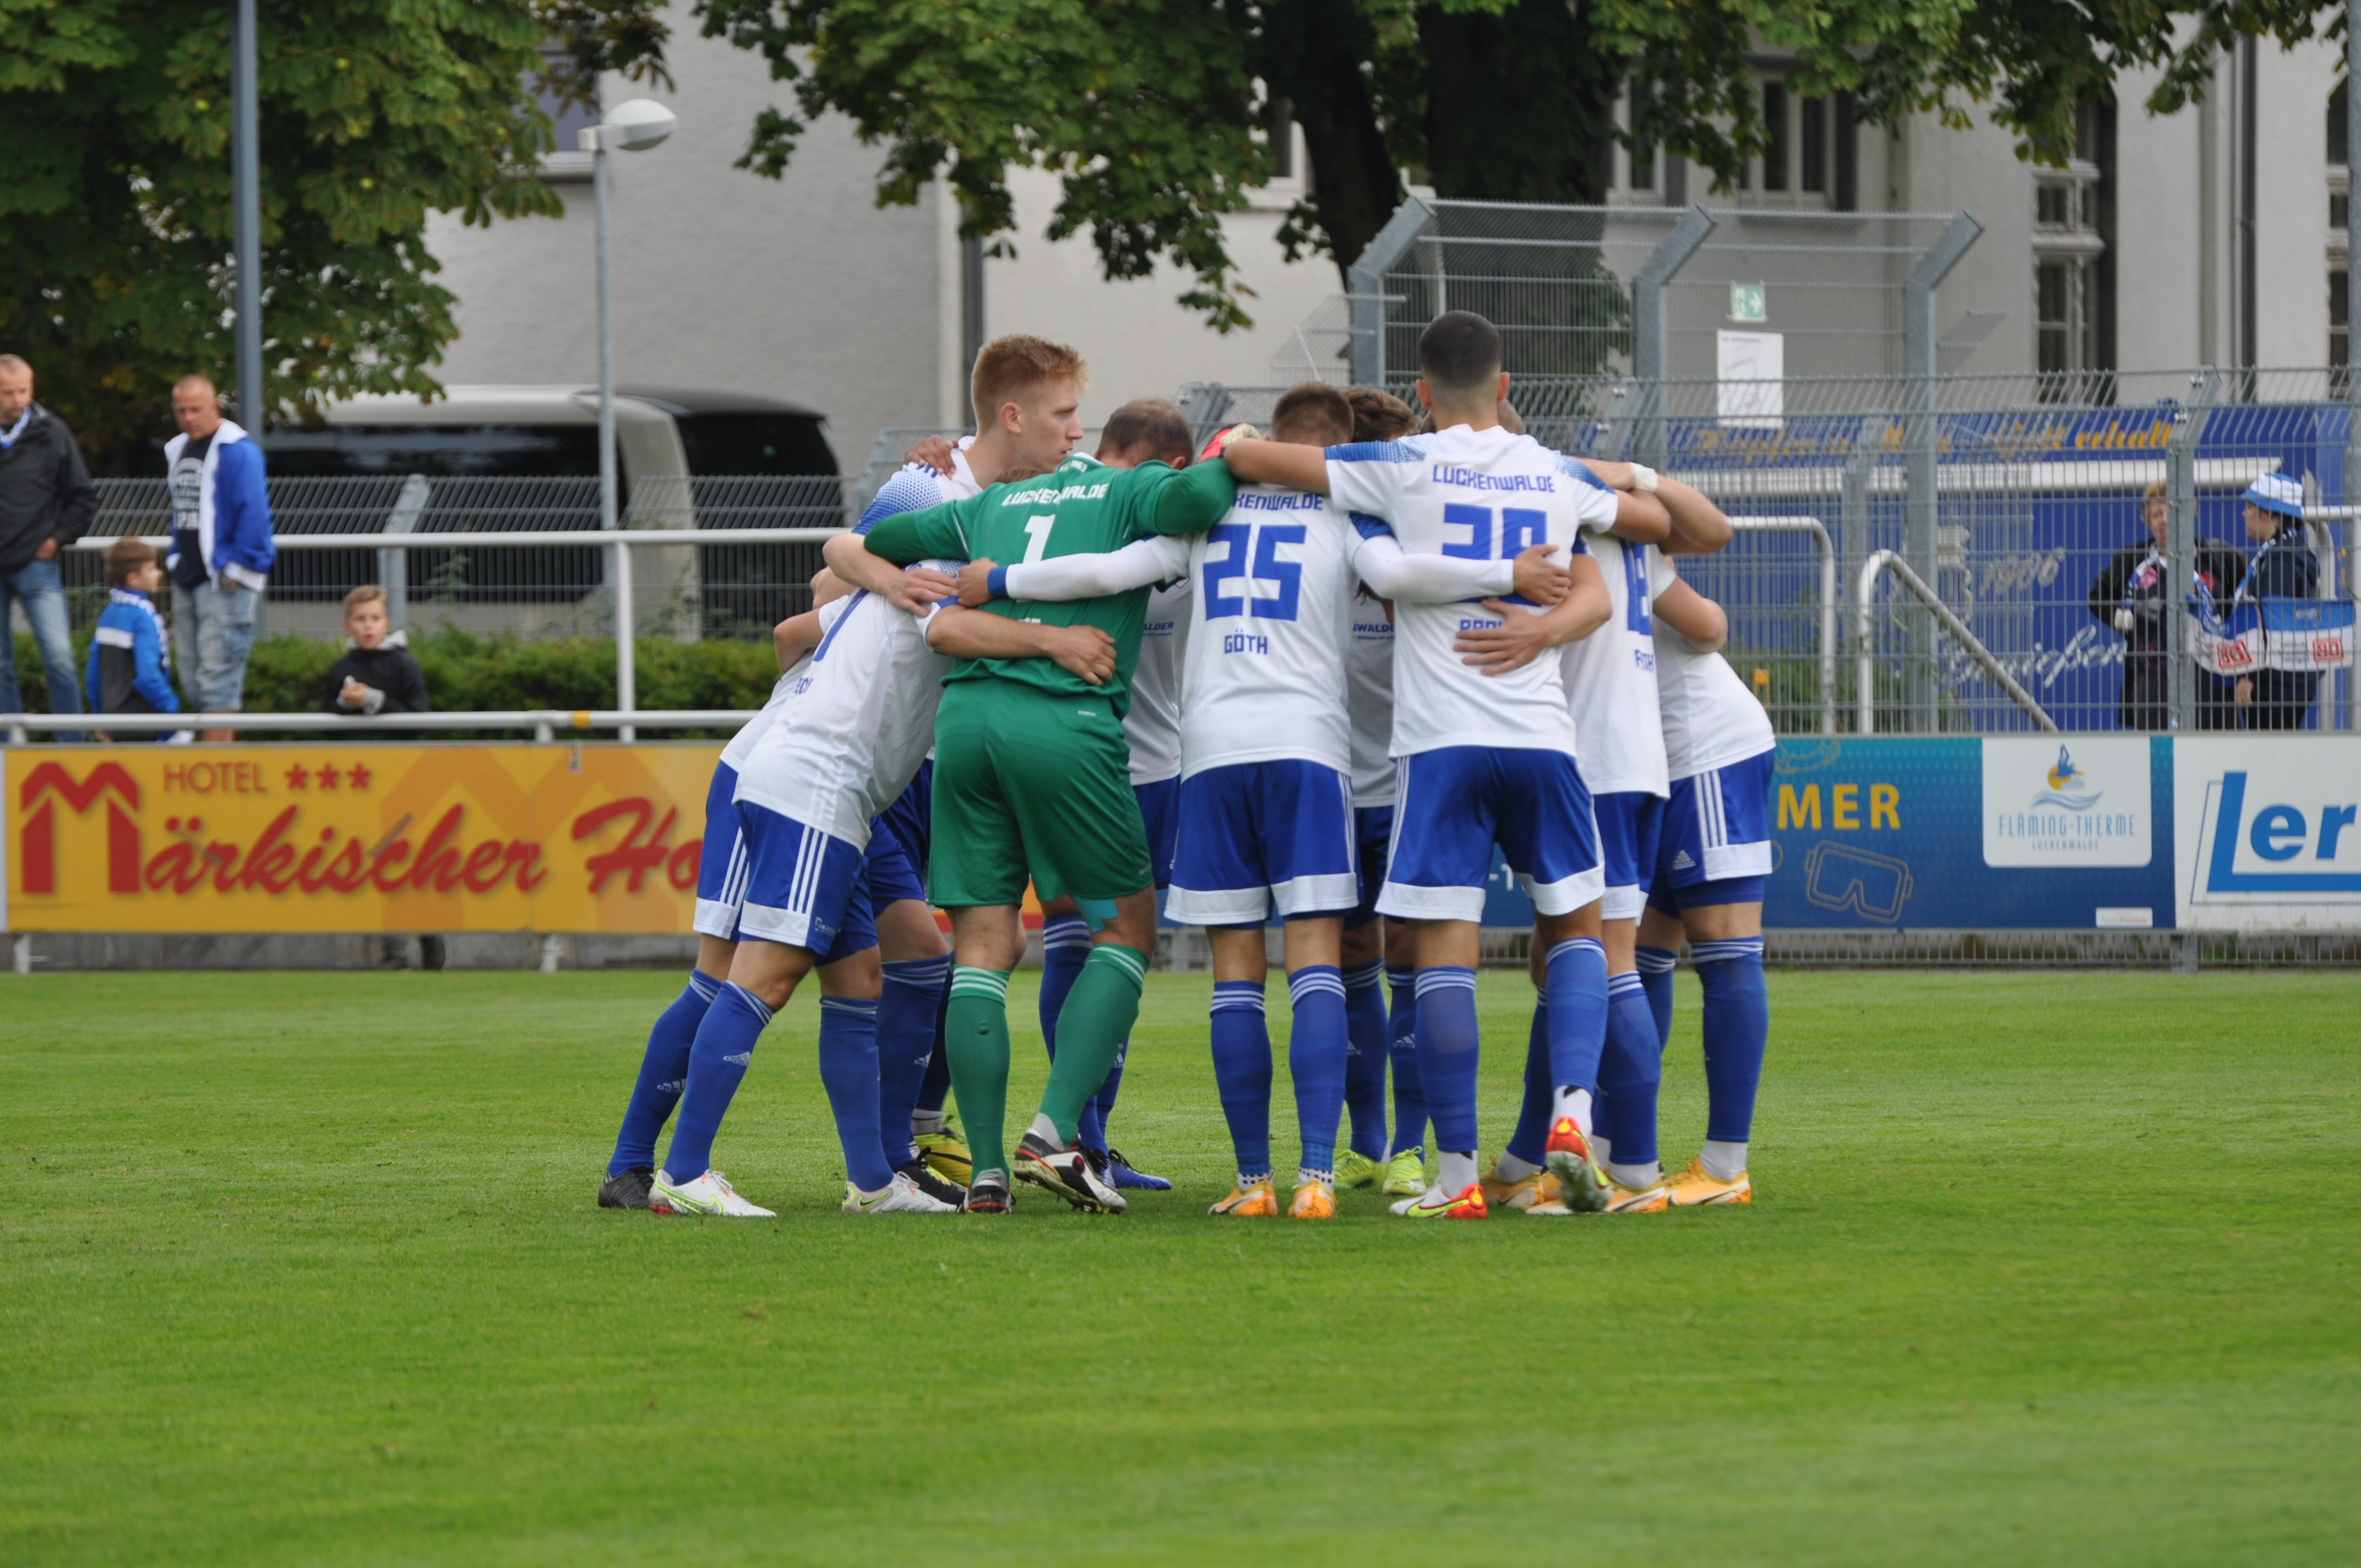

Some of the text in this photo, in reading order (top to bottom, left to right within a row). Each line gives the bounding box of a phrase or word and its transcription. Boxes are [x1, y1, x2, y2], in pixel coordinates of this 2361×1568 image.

[1433, 464, 1555, 493] LUCKENWALDE
[1232, 493, 1323, 510] KENWALDE
[1023, 514, 1056, 564] 1
[1203, 522, 1307, 621] 25
[1224, 629, 1267, 654] GÖTH
[164, 762, 267, 793] HOTEL
[1777, 783, 1901, 830] MER
[20, 761, 703, 895] Märkischer Ho
[1998, 812, 2135, 837] FLÄMING-THERME
[2206, 771, 2361, 892] Ler
[2032, 839, 2099, 851] LUCKENWALDE
